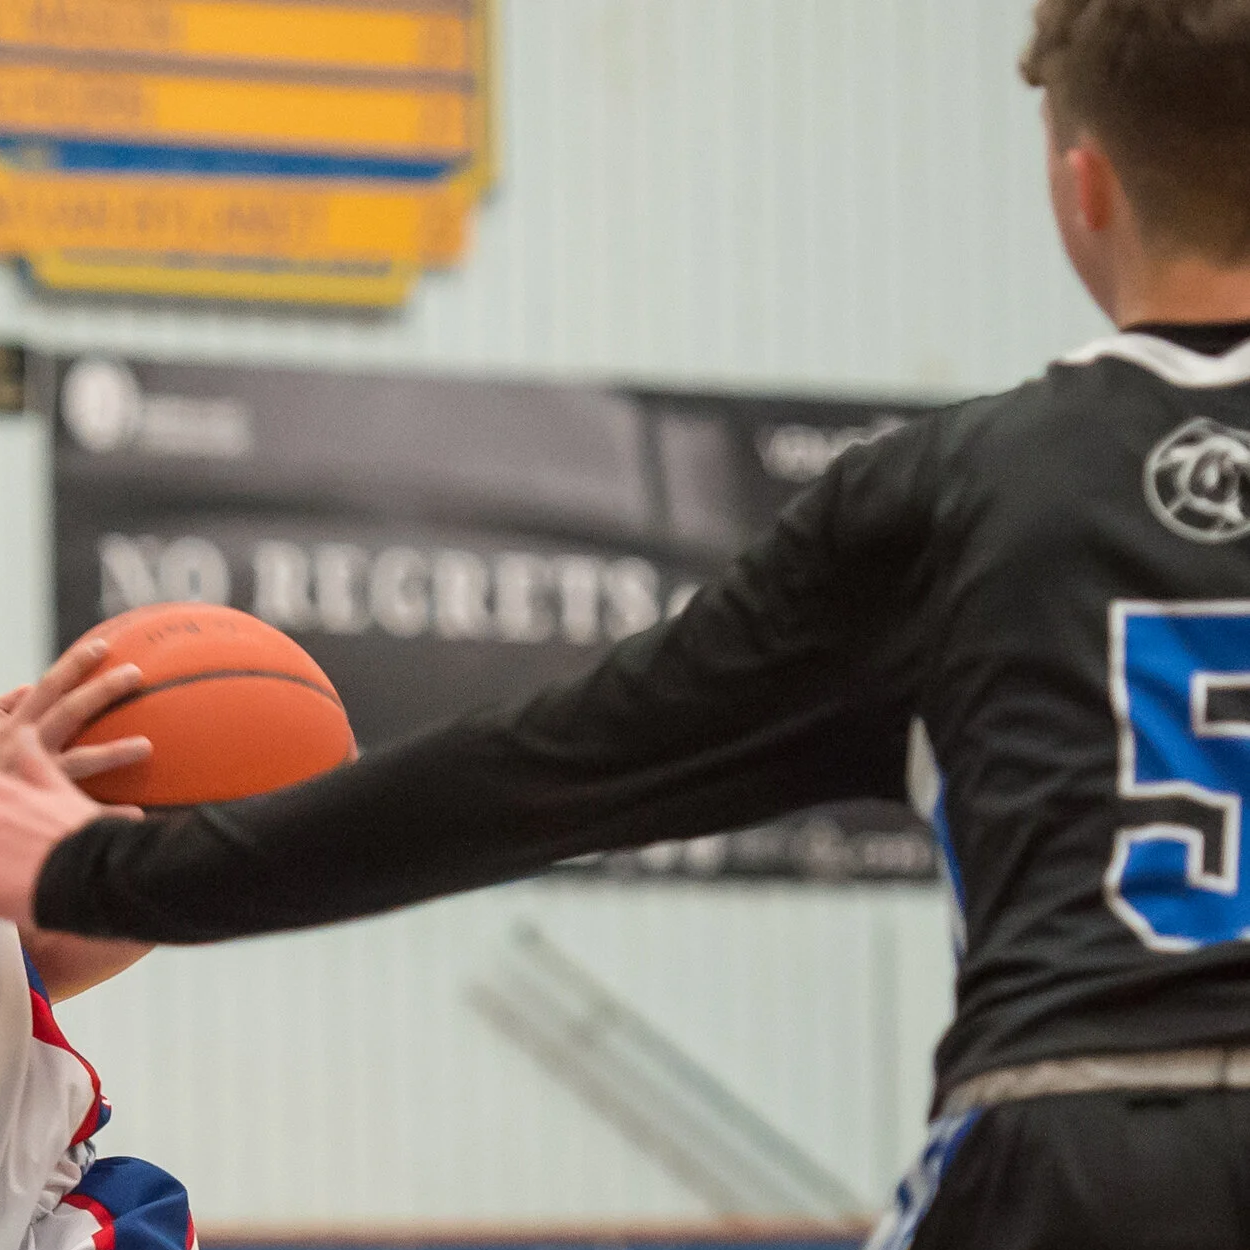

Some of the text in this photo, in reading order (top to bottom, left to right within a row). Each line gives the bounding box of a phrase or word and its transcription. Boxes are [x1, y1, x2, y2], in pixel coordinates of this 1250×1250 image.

[98, 533, 231, 618] NO
[252, 540, 658, 646] REGRETS
[1104, 600, 1250, 952] 5
